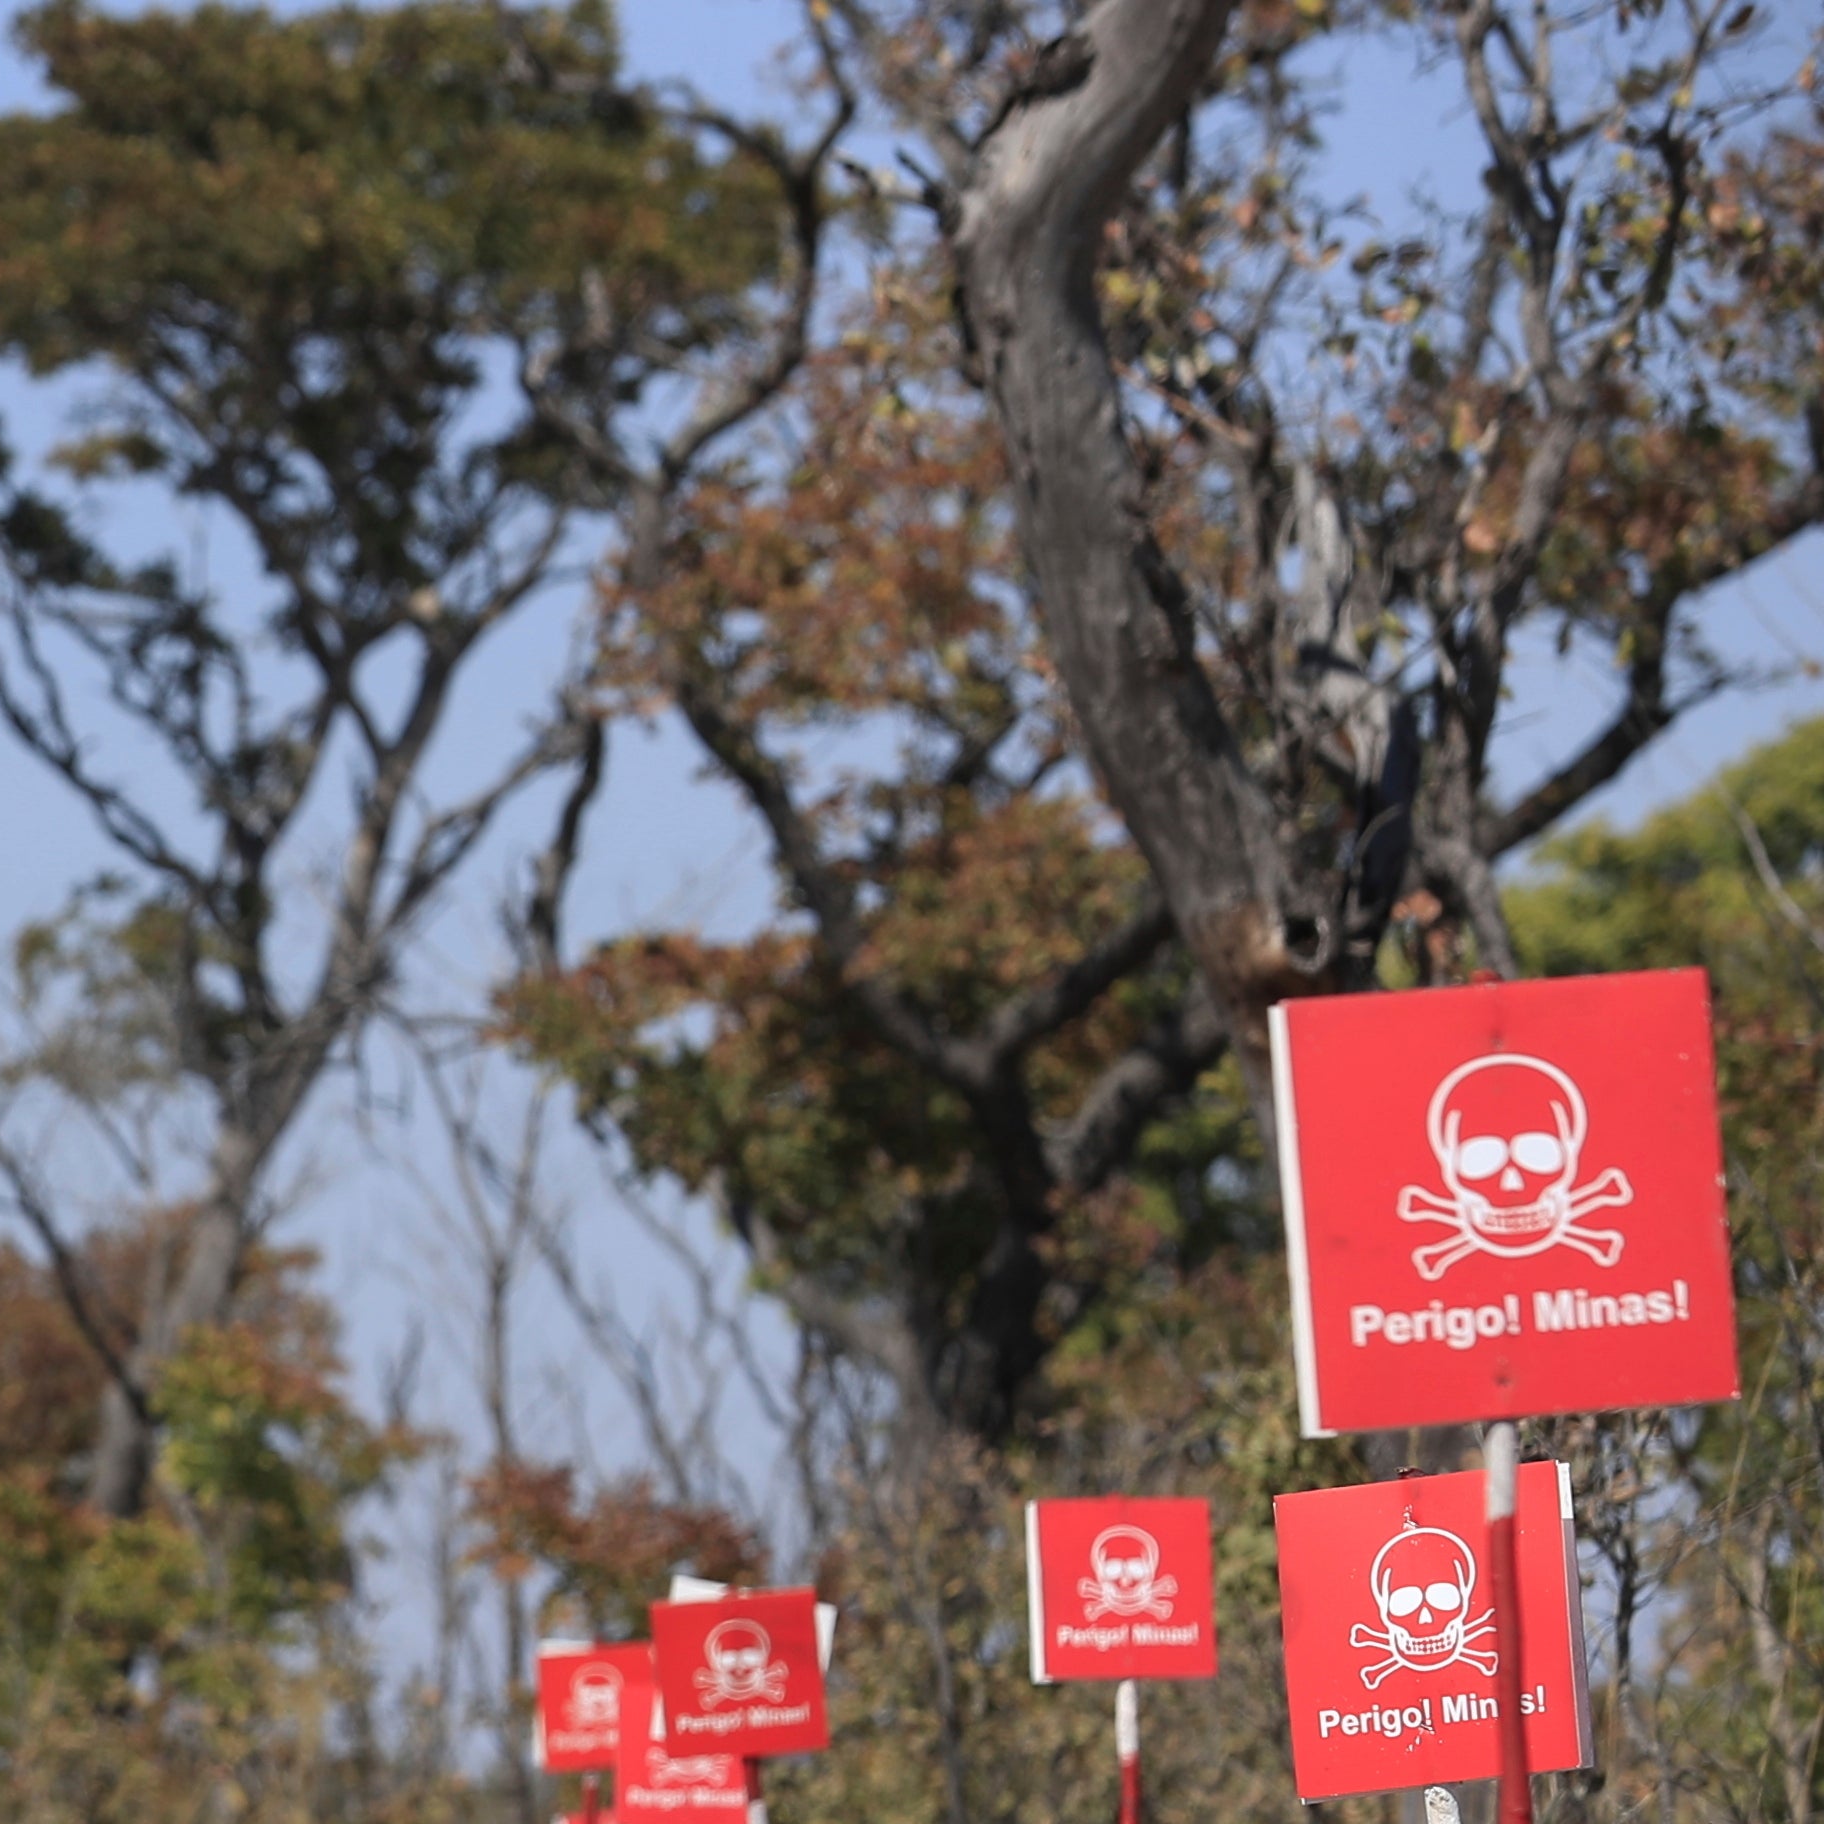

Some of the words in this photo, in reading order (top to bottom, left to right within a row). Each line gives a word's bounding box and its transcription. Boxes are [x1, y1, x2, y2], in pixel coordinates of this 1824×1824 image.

[1349, 1293, 1523, 1350] Perigo!
[1532, 1280, 1690, 1334] Minas!
[1318, 1698, 1435, 1739] Perigo!
[1441, 1686, 1546, 1725] Mins!
